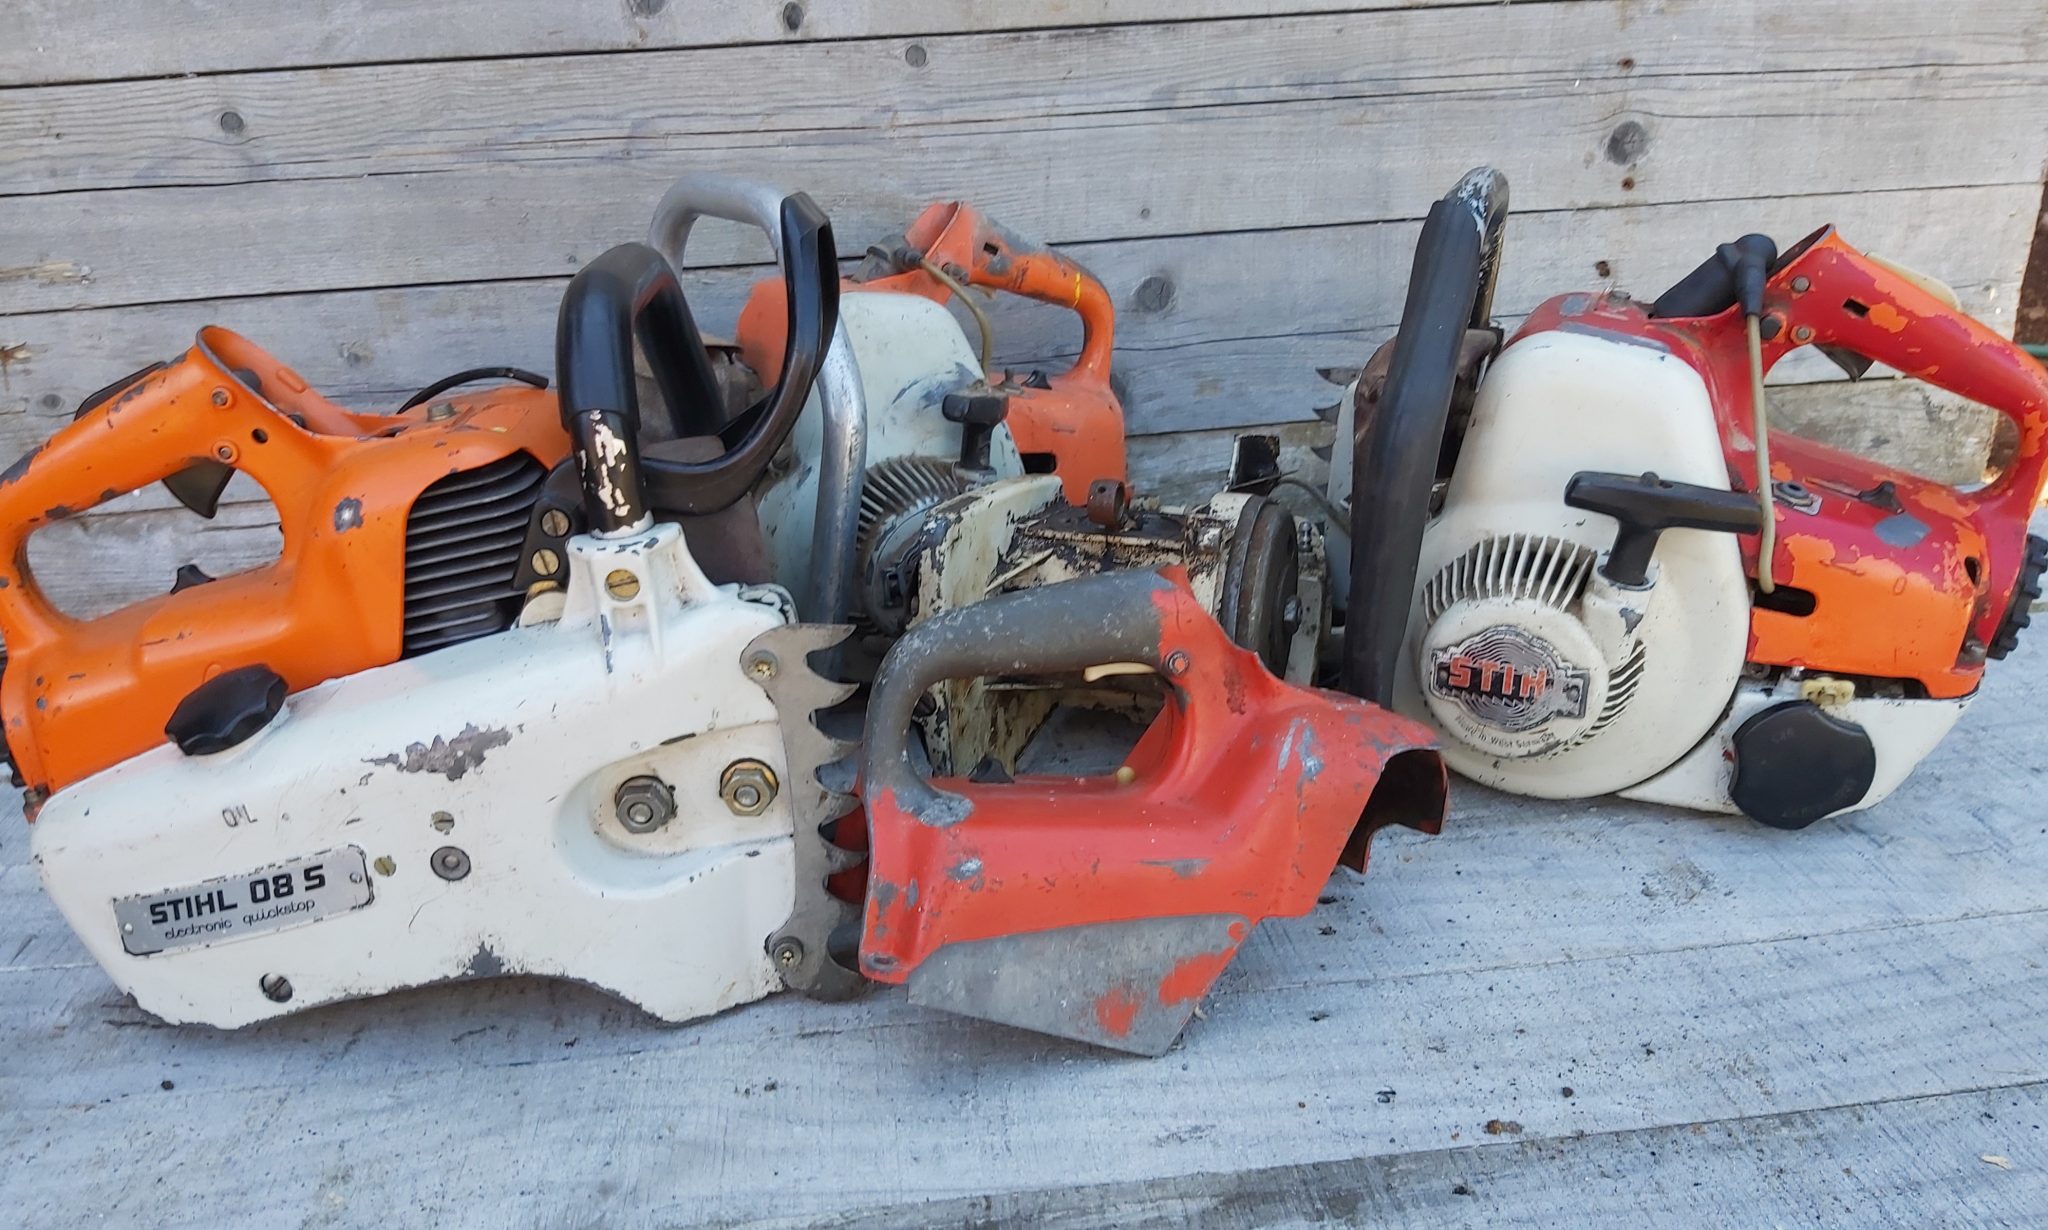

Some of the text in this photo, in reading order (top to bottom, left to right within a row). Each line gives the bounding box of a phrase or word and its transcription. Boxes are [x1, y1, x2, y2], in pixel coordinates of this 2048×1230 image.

[221, 804, 258, 828] OIL
[149, 864, 326, 925] STIHL 08 S
[164, 899, 316, 940] electronic quickstop
